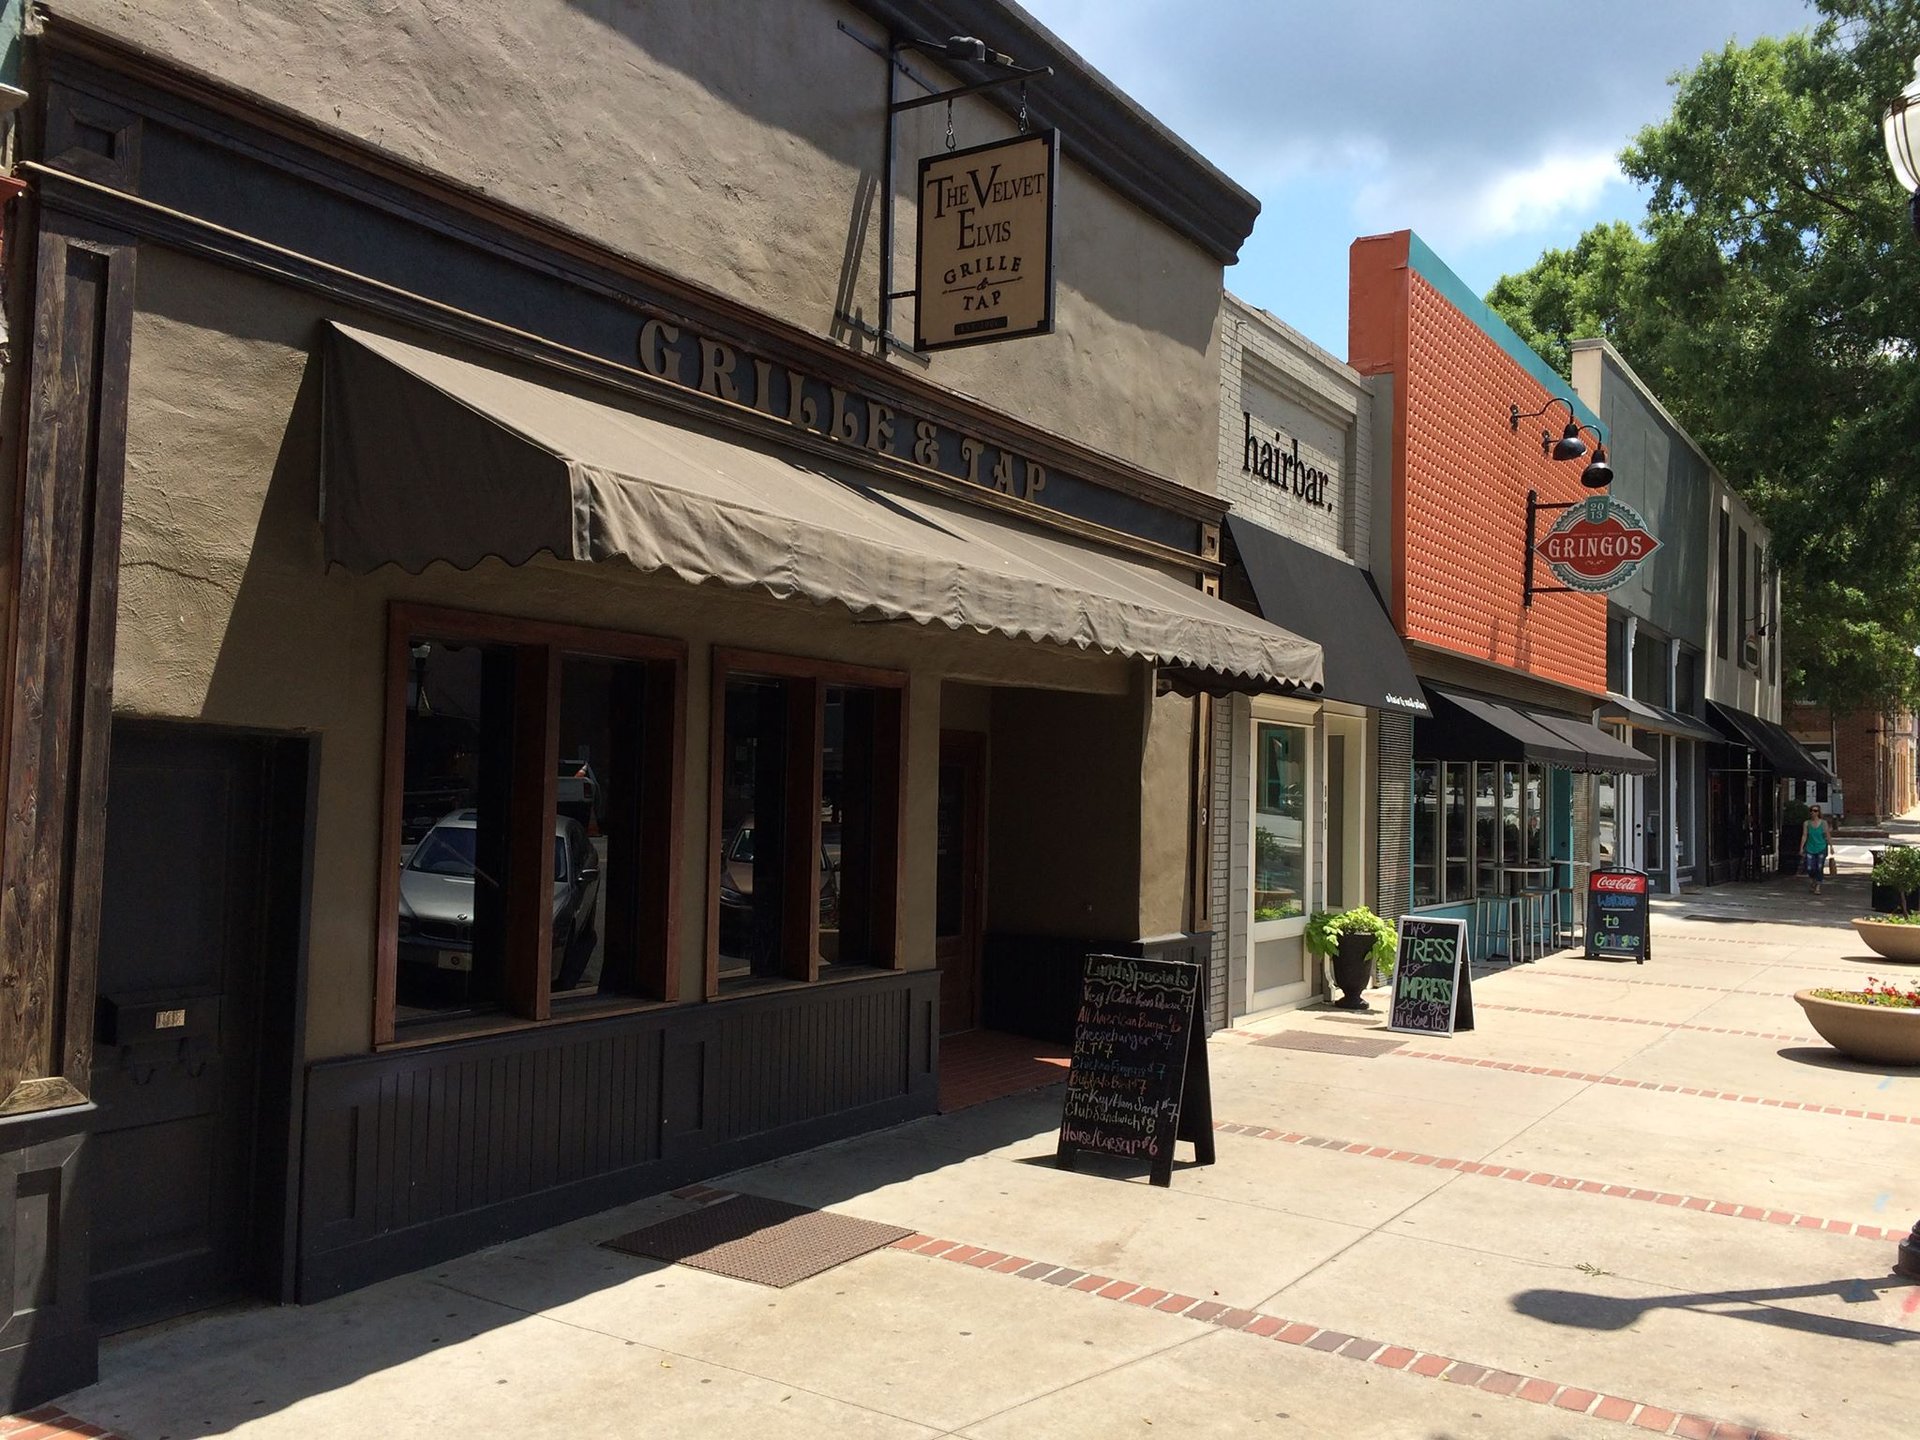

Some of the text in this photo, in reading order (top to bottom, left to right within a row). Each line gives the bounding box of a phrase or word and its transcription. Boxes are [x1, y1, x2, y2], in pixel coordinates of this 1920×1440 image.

[927, 164, 1044, 218] THE VELVET
[957, 208, 1011, 250] ELVIS
[943, 255, 1022, 285] GRILLE
[976, 277, 989, 291] &
[963, 289, 1001, 311] TAP
[640, 319, 1047, 501] GRILLE & TAP
[1242, 411, 1333, 512] hairbar.
[1590, 502, 1604, 511] 20
[1591, 511, 1602, 519] 13
[1548, 535, 1642, 558] GRINGOS
[1597, 876, 1638, 890] Coca-Cola
[1603, 915, 1619, 927] to
[1403, 937, 1455, 963] TRESS
[1087, 957, 1188, 991] Lunch Specials
[1400, 976, 1453, 1004] IMPRESS
[1065, 1102, 1093, 1119] Club
[1092, 1107, 1140, 1131] Sandwich
